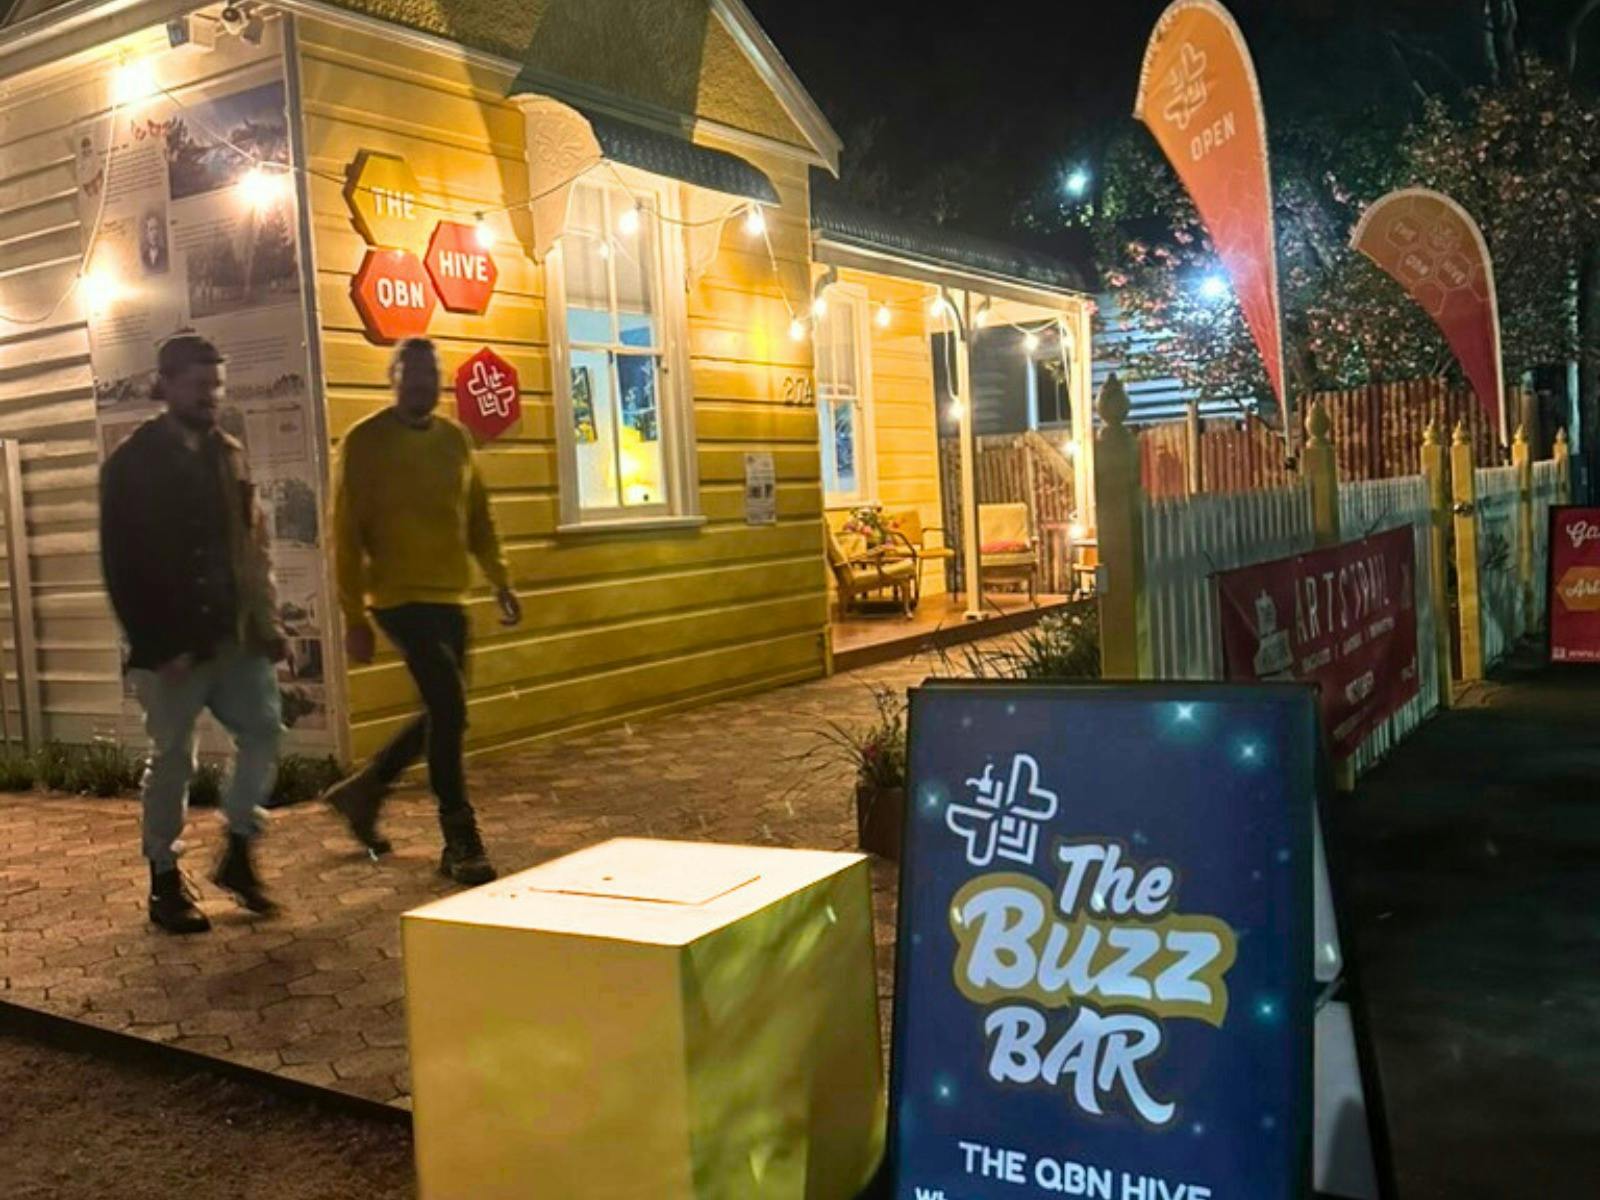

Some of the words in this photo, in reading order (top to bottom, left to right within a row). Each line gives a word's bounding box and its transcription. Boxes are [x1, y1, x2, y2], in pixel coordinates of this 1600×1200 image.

[1190, 111, 1236, 161] OPEN
[371, 188, 417, 219] THE
[438, 250, 489, 282] HIVE
[376, 277, 425, 309] QBN
[1059, 843, 1174, 916] The
[984, 1004, 1176, 1125] BAR
[958, 1140, 1027, 1184] THE
[1034, 1157, 1113, 1200] QBN
